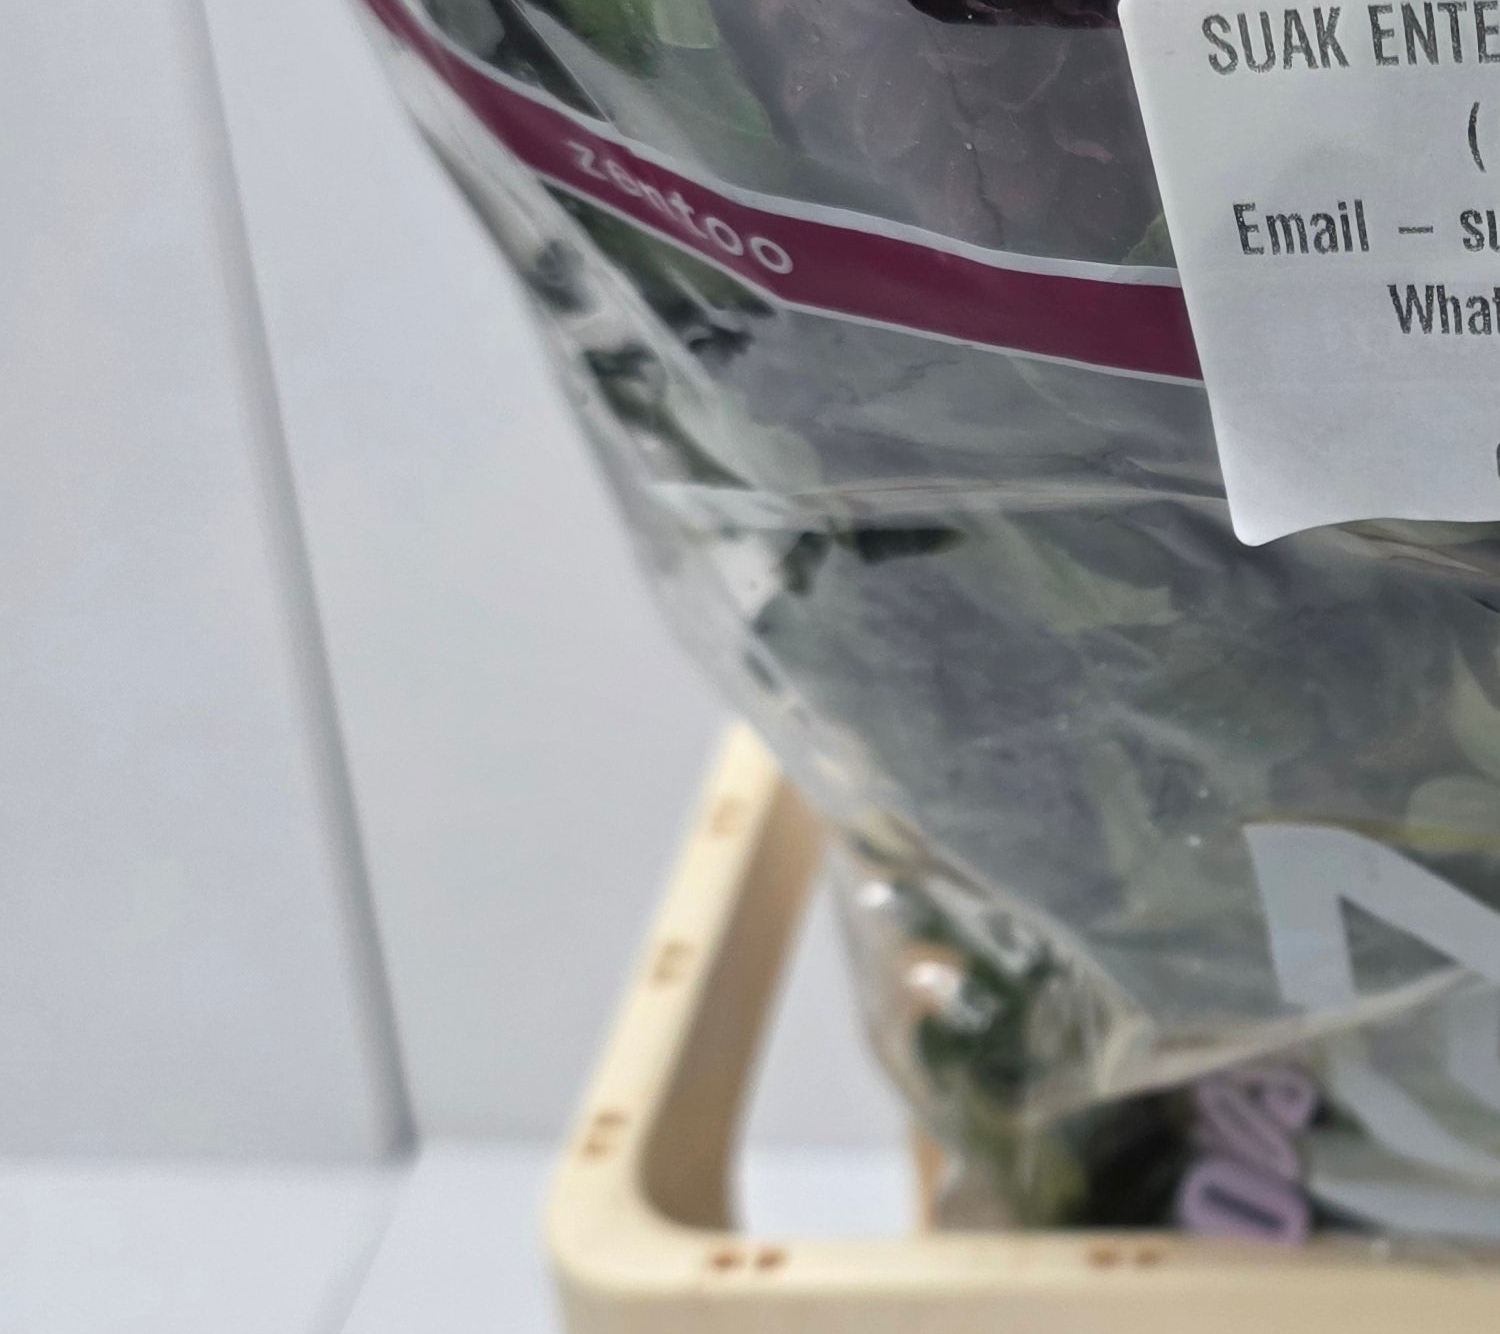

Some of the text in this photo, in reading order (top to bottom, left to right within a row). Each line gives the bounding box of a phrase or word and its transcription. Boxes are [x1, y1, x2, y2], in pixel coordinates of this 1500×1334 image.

[1202, 5, 1349, 74] SUAK
[565, 137, 795, 276] zentoo
[1232, 198, 1370, 256] Email
